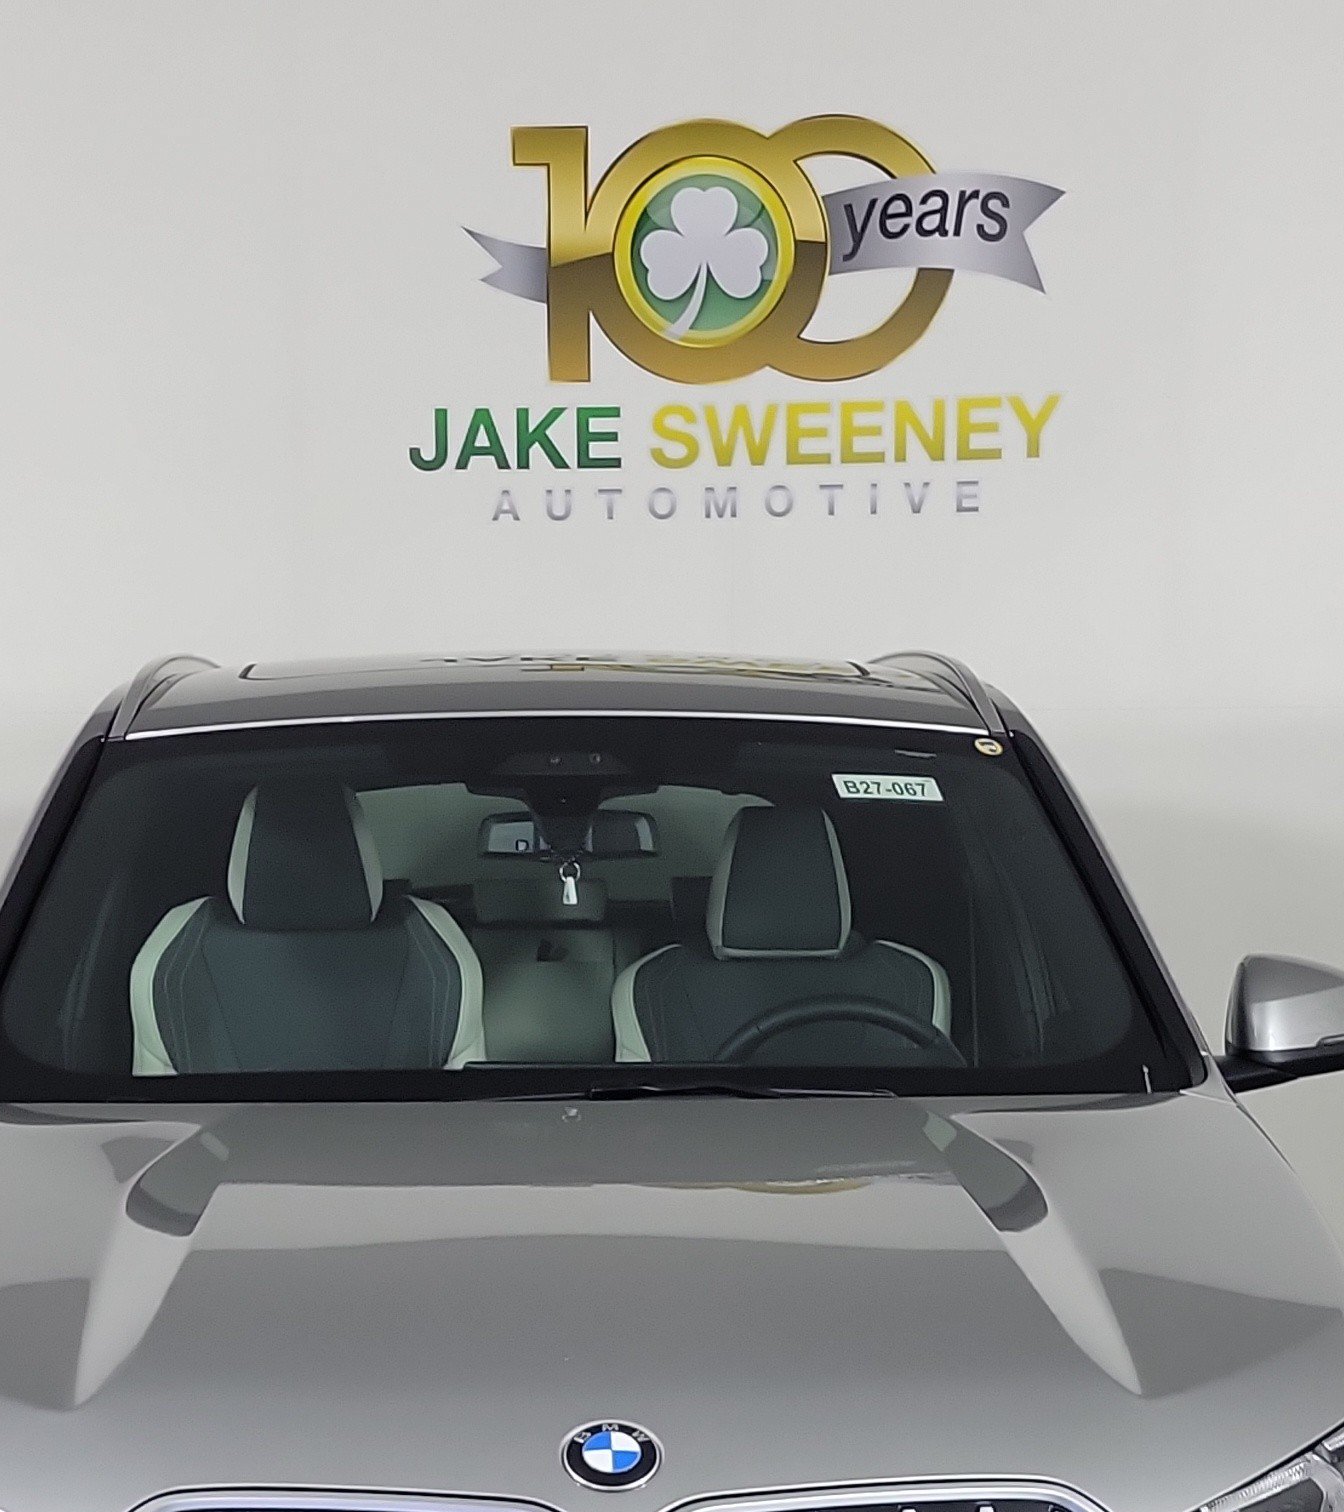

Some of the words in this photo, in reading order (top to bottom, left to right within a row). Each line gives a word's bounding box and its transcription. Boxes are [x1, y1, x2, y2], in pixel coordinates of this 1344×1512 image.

[842, 186, 1010, 263] years
[408, 406, 622, 472] JAKE
[649, 394, 1061, 470] SWEENEY
[492, 480, 980, 522] AUTOMOTIVE
[843, 780, 926, 797] B27-067
[573, 1423, 650, 1443] BMW
